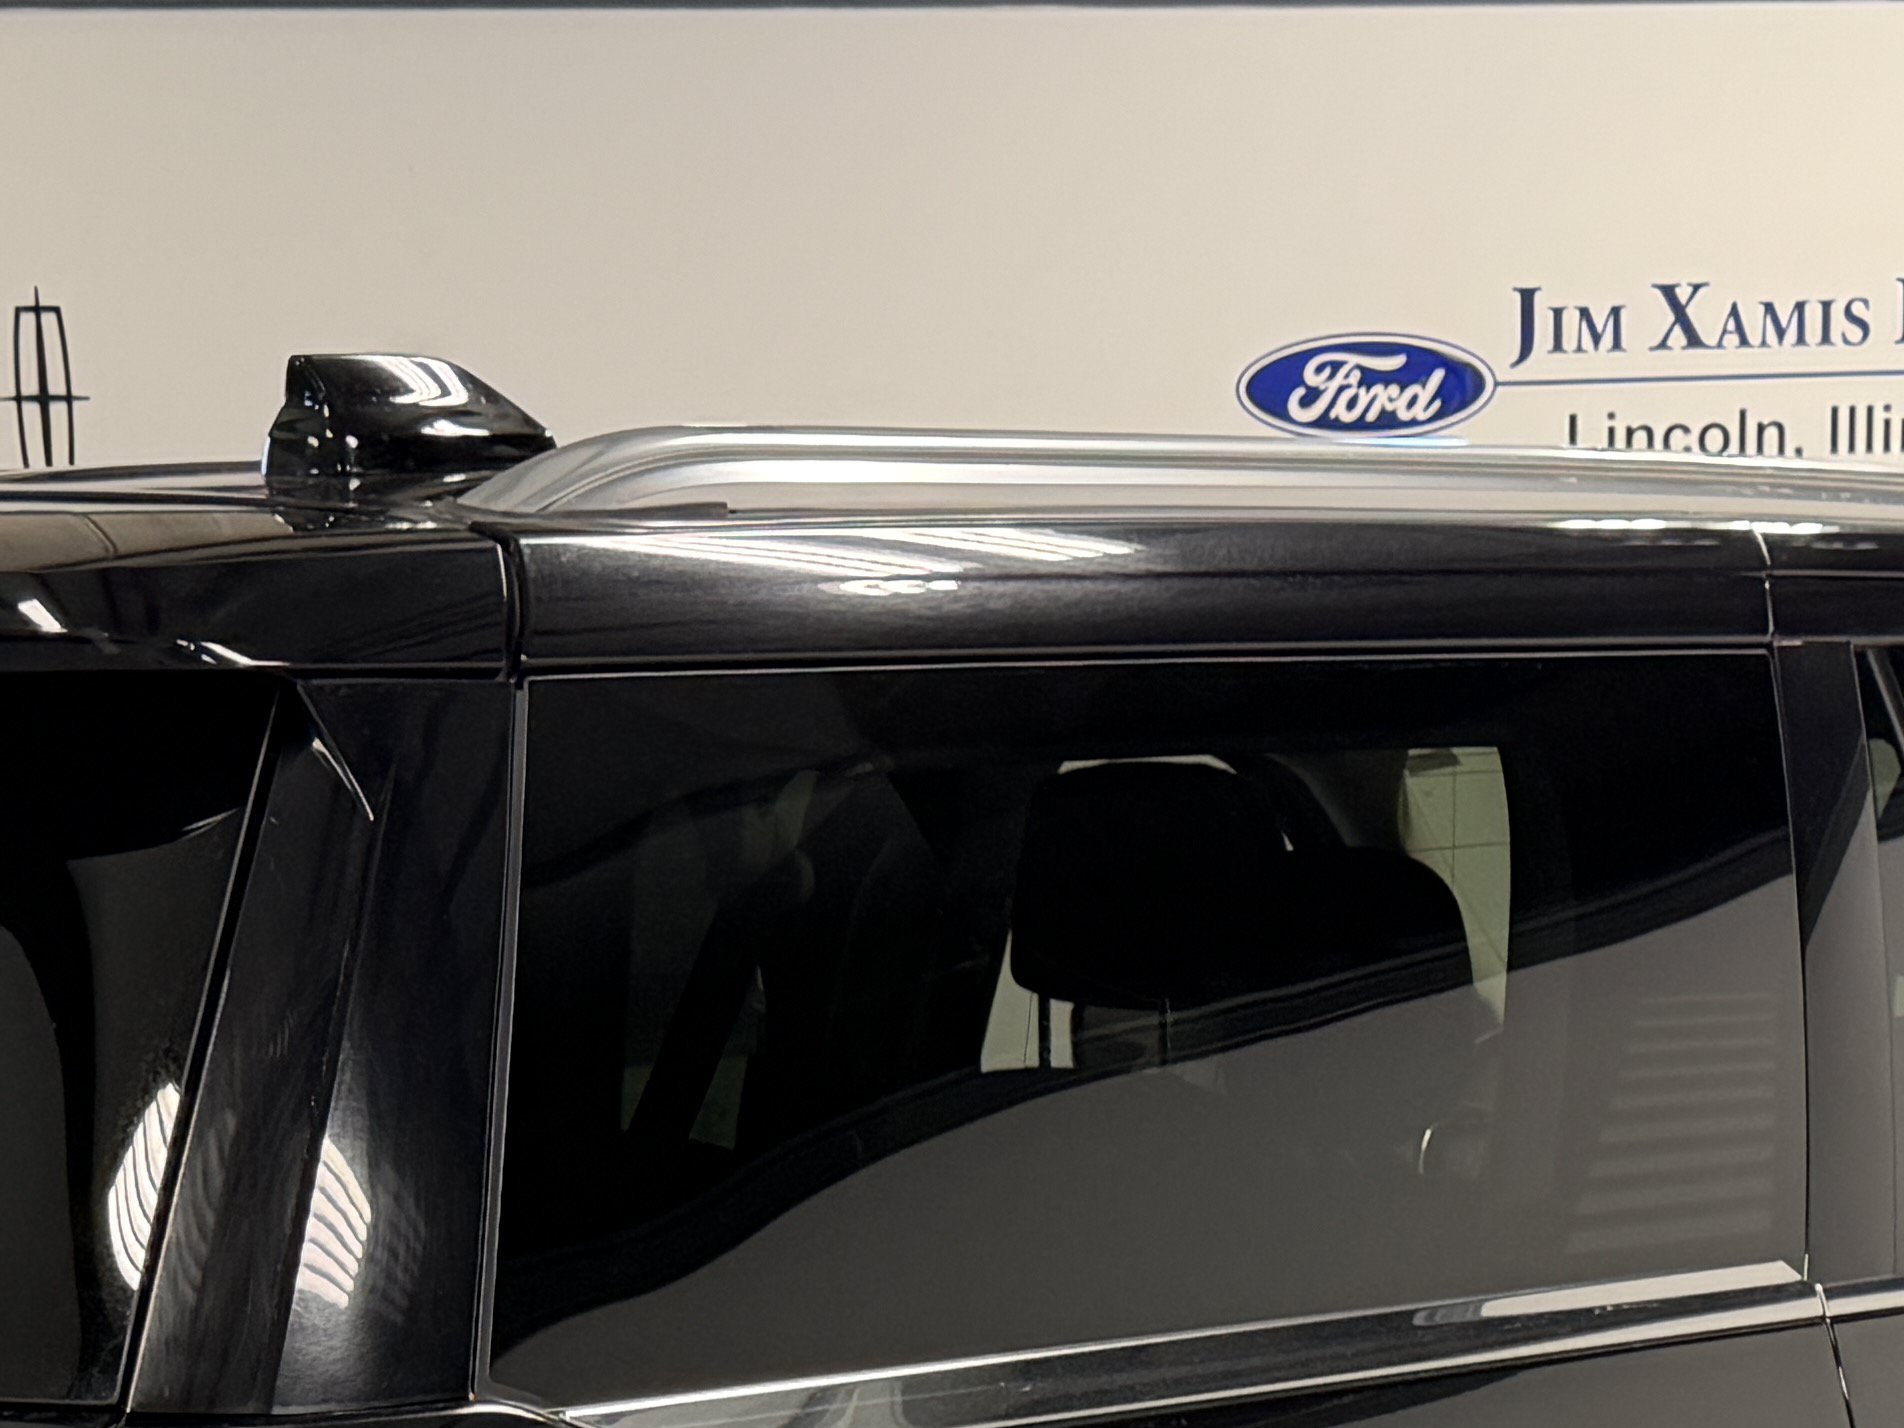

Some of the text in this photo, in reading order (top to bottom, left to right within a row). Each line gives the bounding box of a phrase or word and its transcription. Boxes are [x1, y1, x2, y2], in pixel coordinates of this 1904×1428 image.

[1509, 286, 1626, 369] JIM
[1648, 280, 1871, 352] XAMIS
[1286, 351, 1446, 425] Ford
